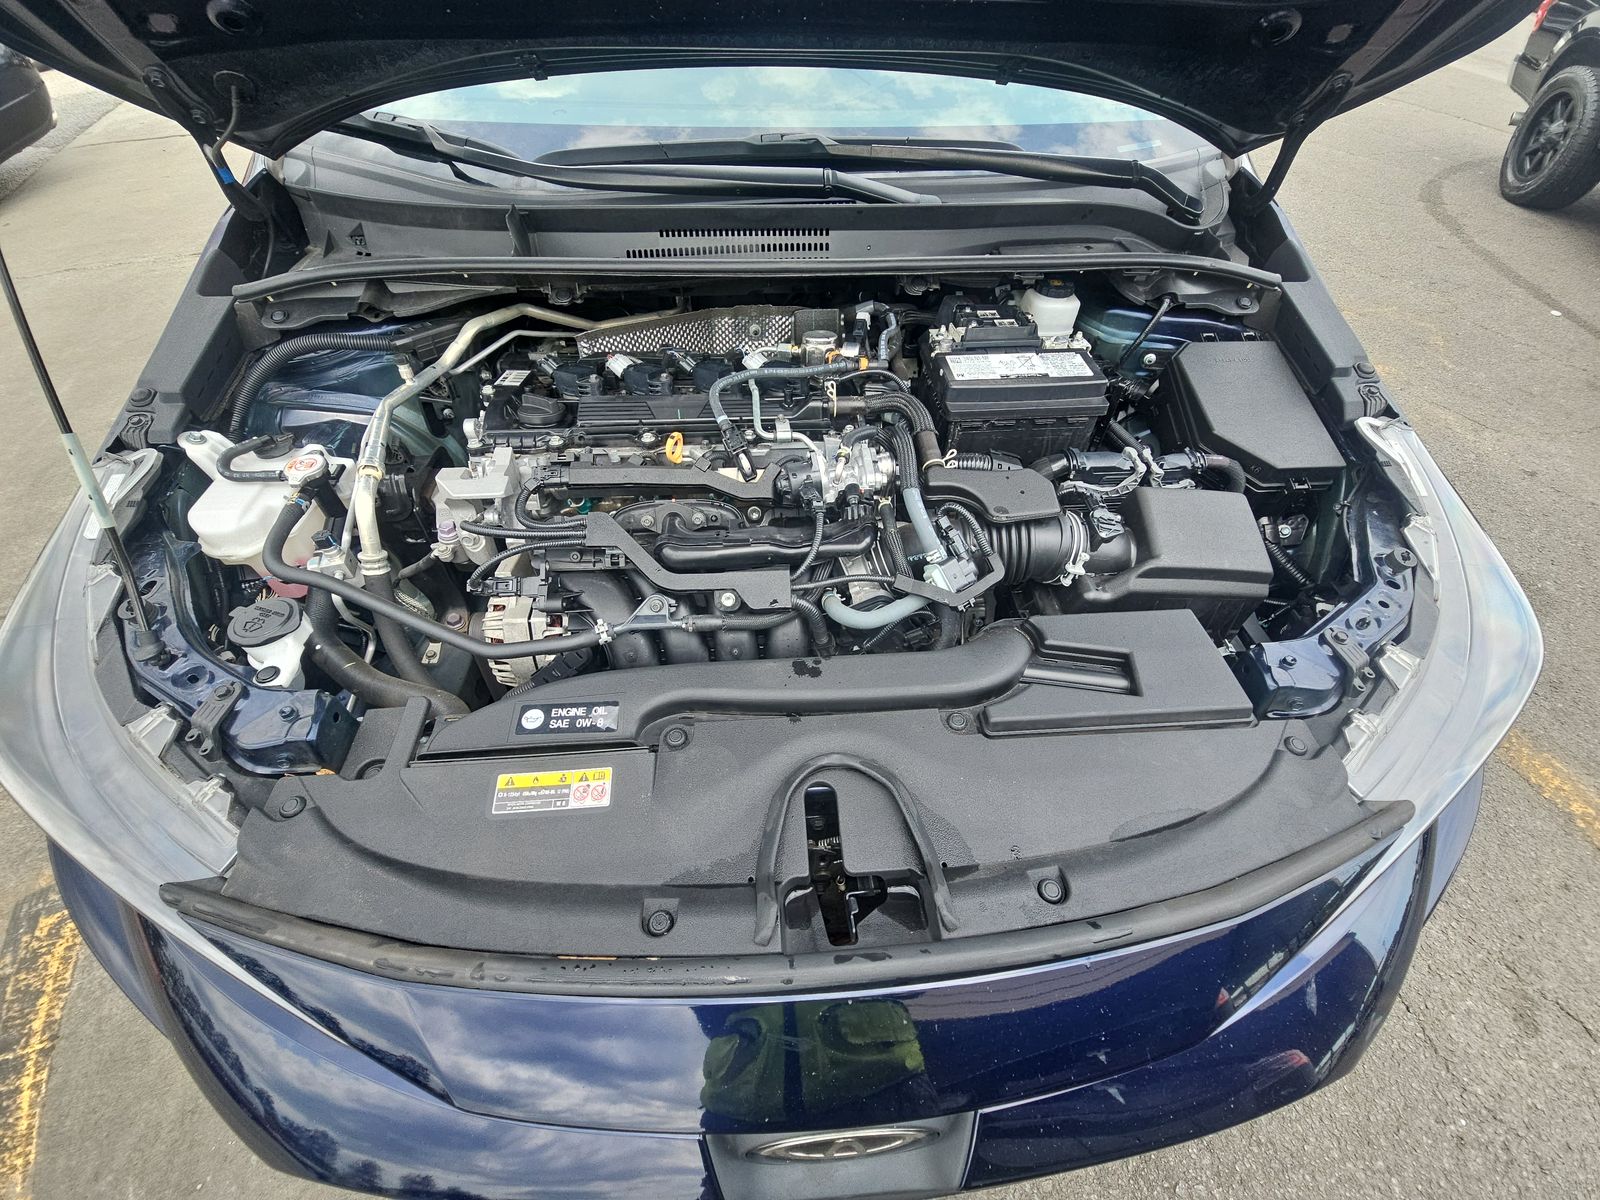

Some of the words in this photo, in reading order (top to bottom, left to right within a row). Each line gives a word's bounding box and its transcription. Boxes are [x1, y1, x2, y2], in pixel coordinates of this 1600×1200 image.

[551, 707, 587, 717] ENGINE
[592, 705, 608, 715] OIL
[549, 719, 570, 728] SAE
